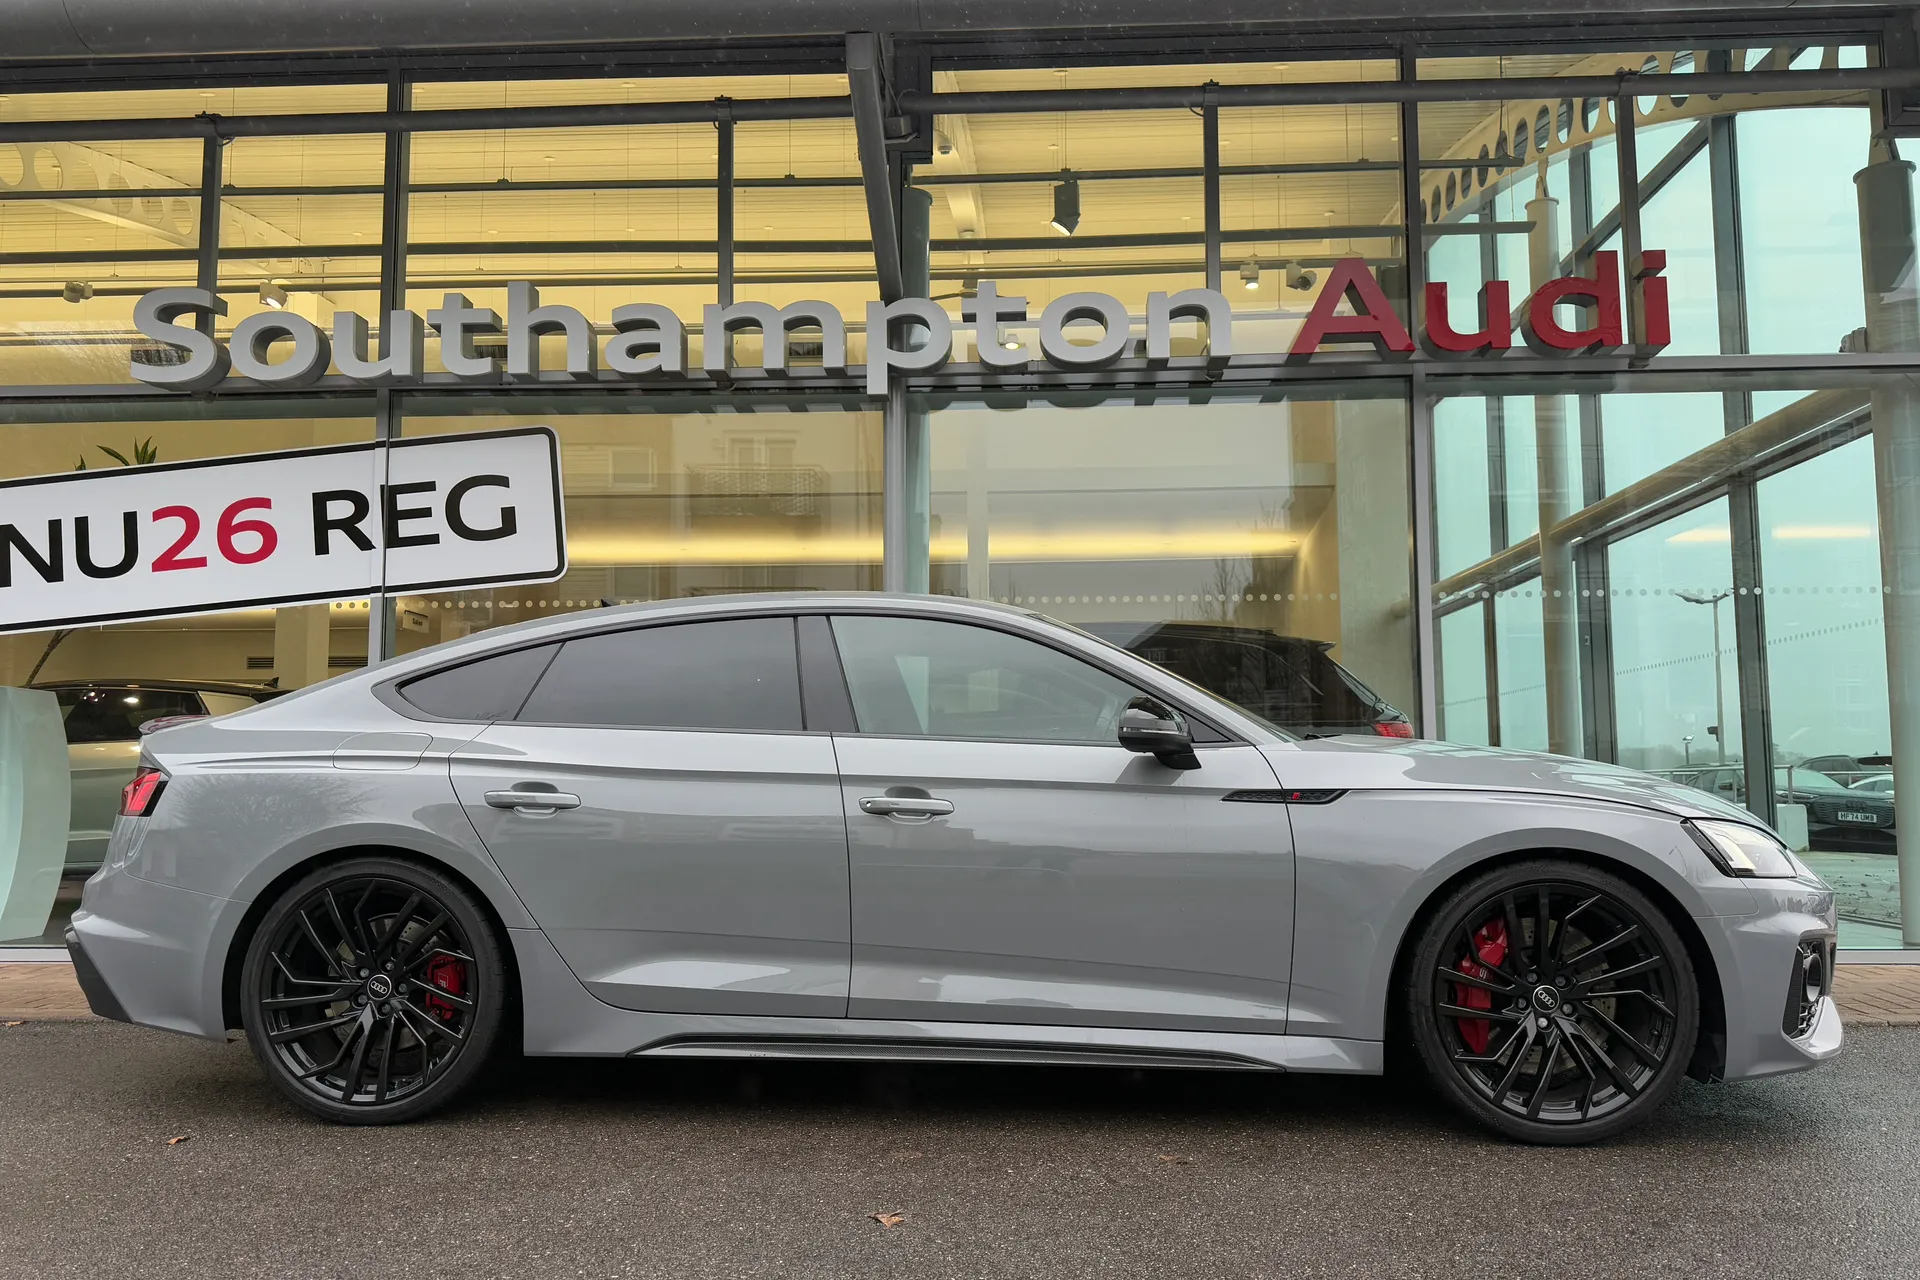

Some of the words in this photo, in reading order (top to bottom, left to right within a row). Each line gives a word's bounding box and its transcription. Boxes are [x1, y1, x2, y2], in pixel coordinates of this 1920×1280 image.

[130, 281, 1232, 398] Southampton
[1290, 249, 1671, 357] Audi
[0, 497, 278, 587] NU26
[311, 474, 517, 556] REG
